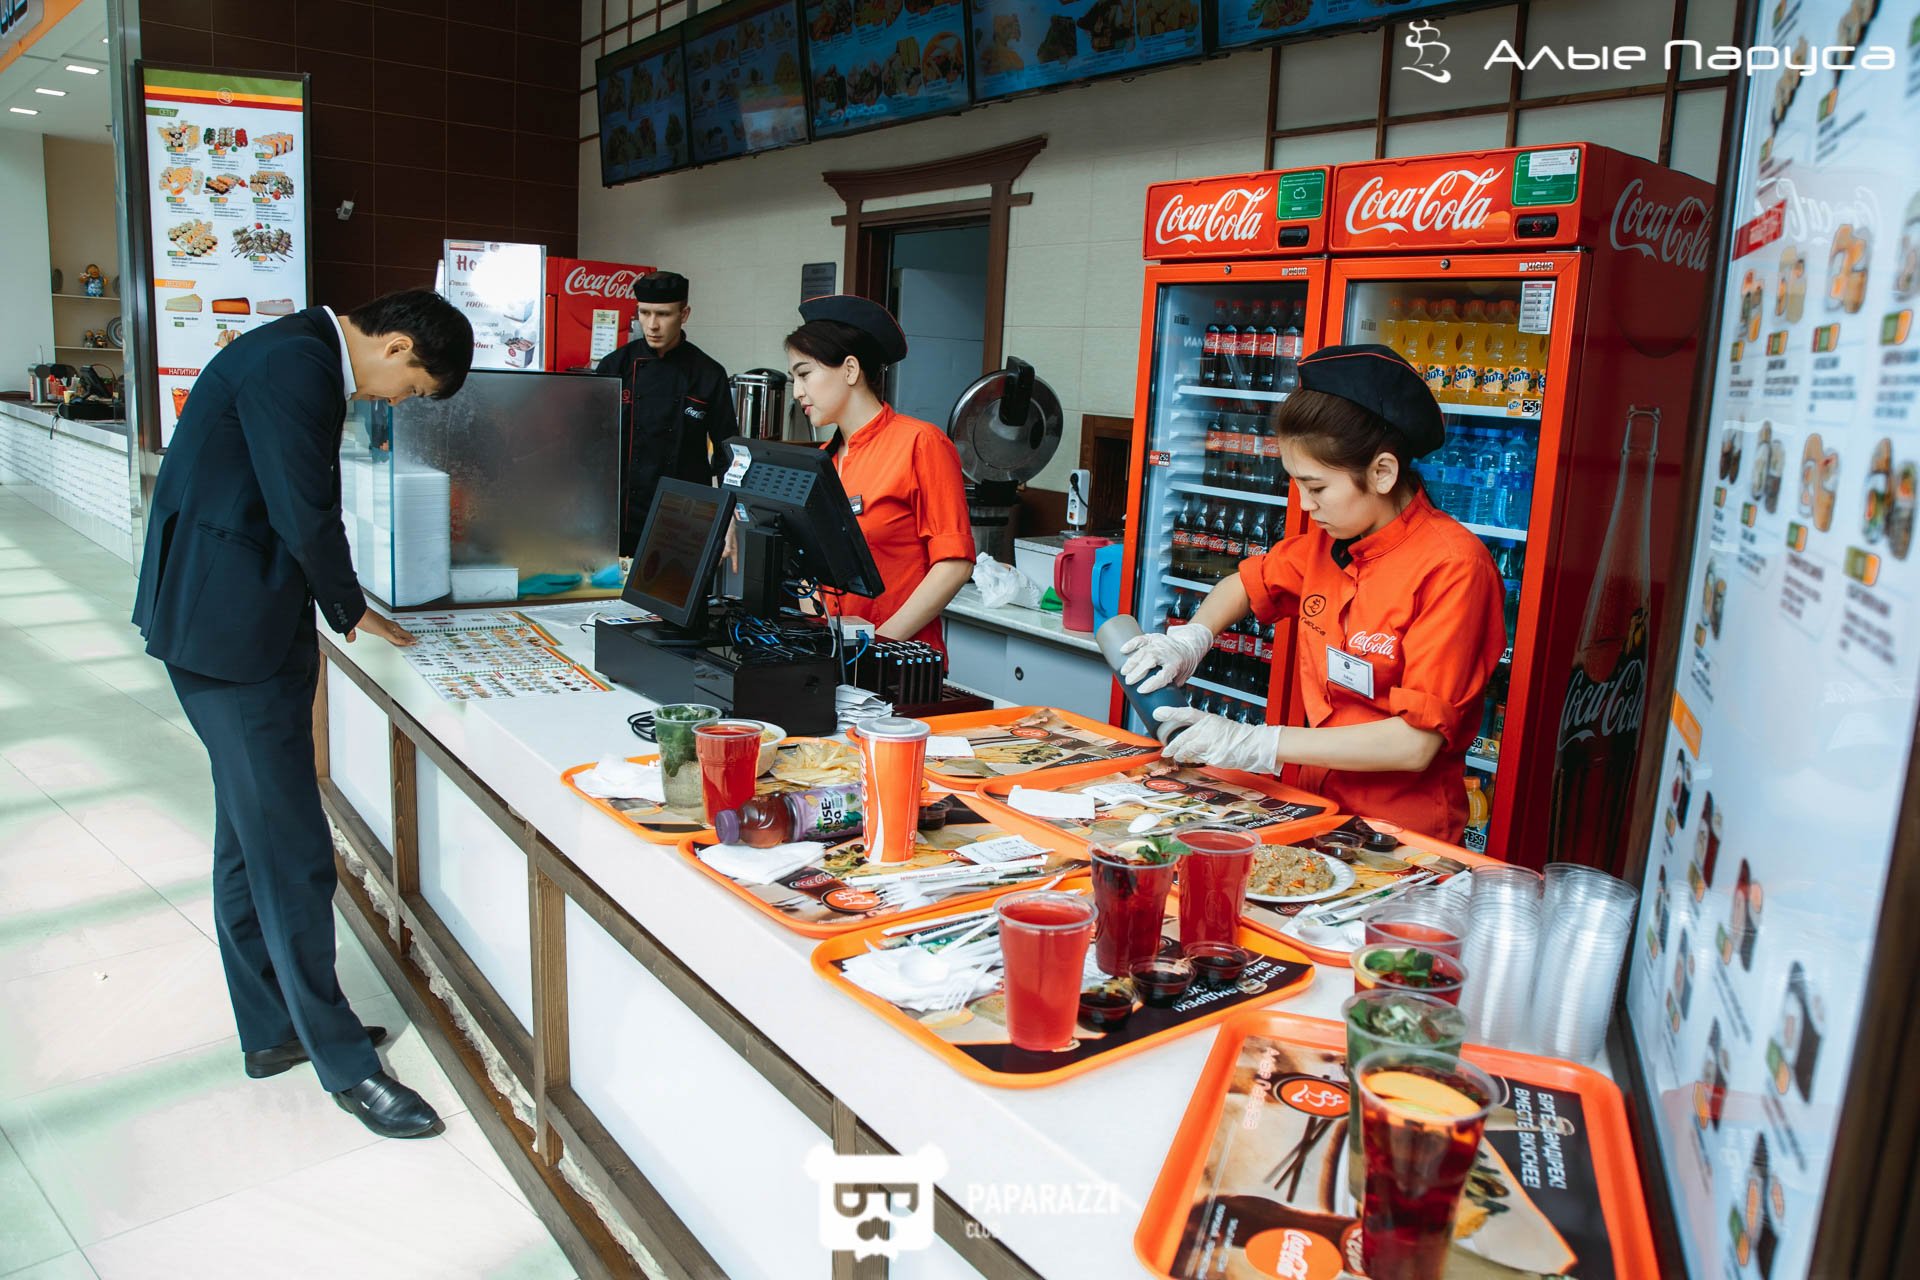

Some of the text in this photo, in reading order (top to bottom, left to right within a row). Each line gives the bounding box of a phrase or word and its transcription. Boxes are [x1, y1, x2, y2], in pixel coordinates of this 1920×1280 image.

[1155, 186, 1273, 245] Coca-Cola
[1345, 166, 1506, 236] Coca-Cola
[1610, 178, 1714, 272] Coca-Cola
[168, 368, 198, 376] НАПИТКИ
[1514, 1086, 1542, 1190] ВМЕСТЕ ВКУСНЕЕ!
